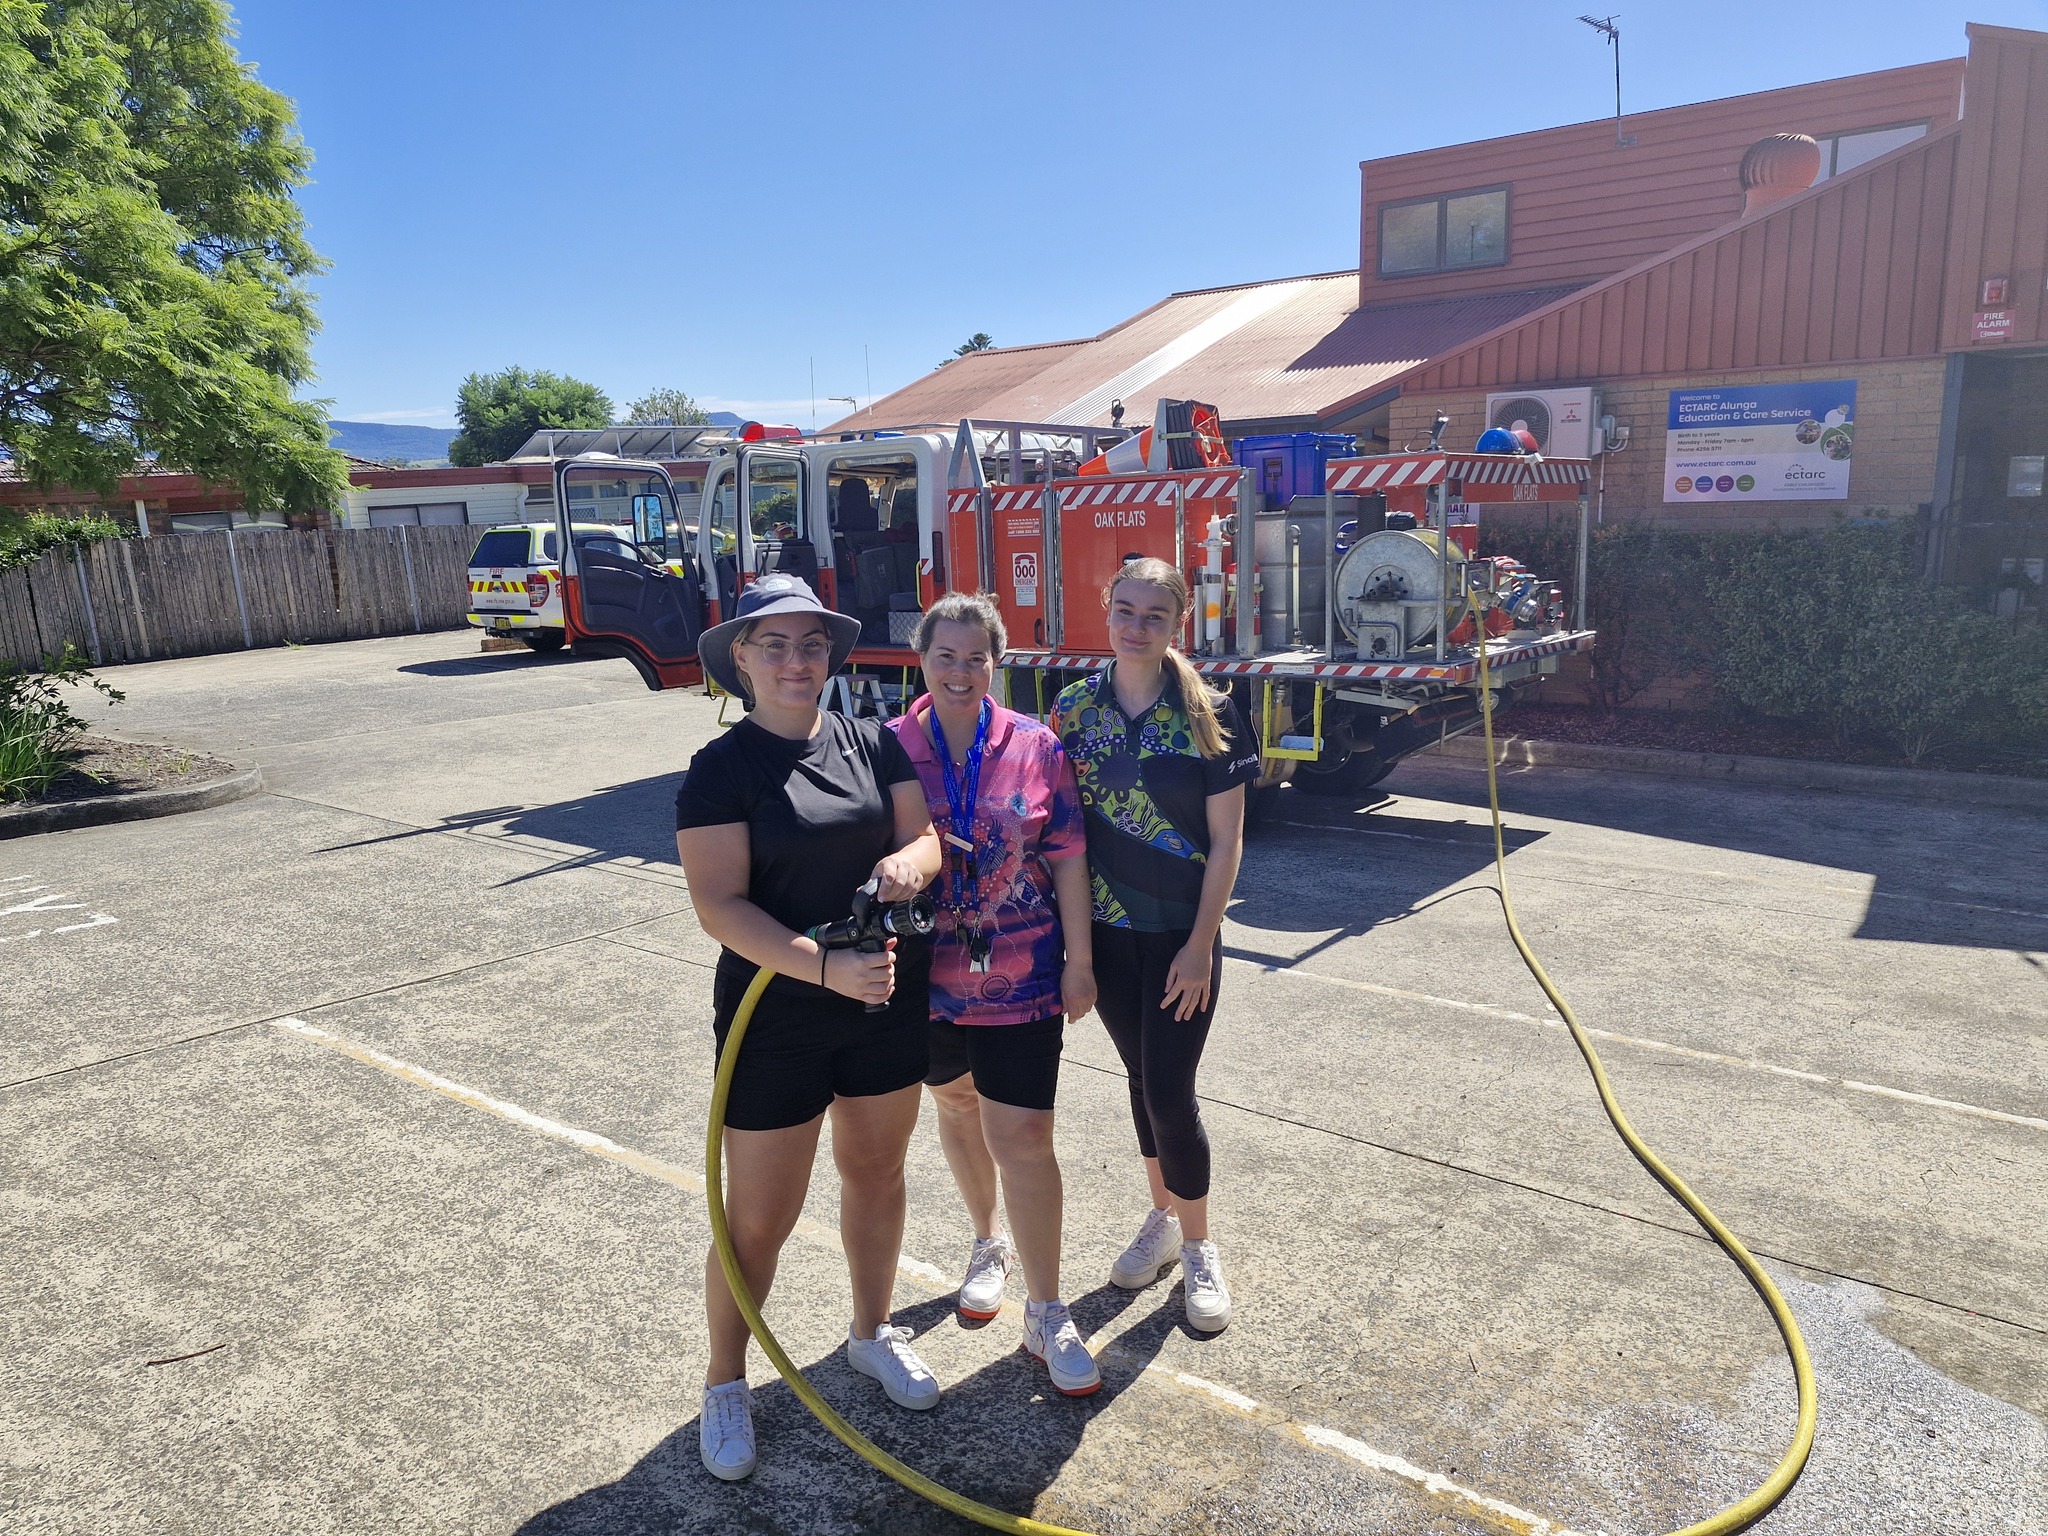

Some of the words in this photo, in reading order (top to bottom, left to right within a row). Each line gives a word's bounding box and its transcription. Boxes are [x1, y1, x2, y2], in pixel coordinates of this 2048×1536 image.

[1984, 312, 2005, 320] FIRE
[1977, 319, 2010, 328] ALARM
[1679, 402, 1718, 413] ECTARC
[1720, 401, 1757, 411] Alunga
[1678, 412, 1730, 423] Education
[1732, 411, 1741, 420] &
[1743, 411, 1769, 420] Care
[1770, 408, 1812, 418] Service
[1676, 460, 1756, 468] www.ectarc.com.au
[1785, 471, 1826, 479] ectarc
[1513, 484, 1523, 501] OAK
[1524, 484, 1538, 501] FLATS
[1094, 511, 1115, 528] OAK
[1117, 510, 1146, 527] FLATS
[1015, 564, 1035, 578] 000
